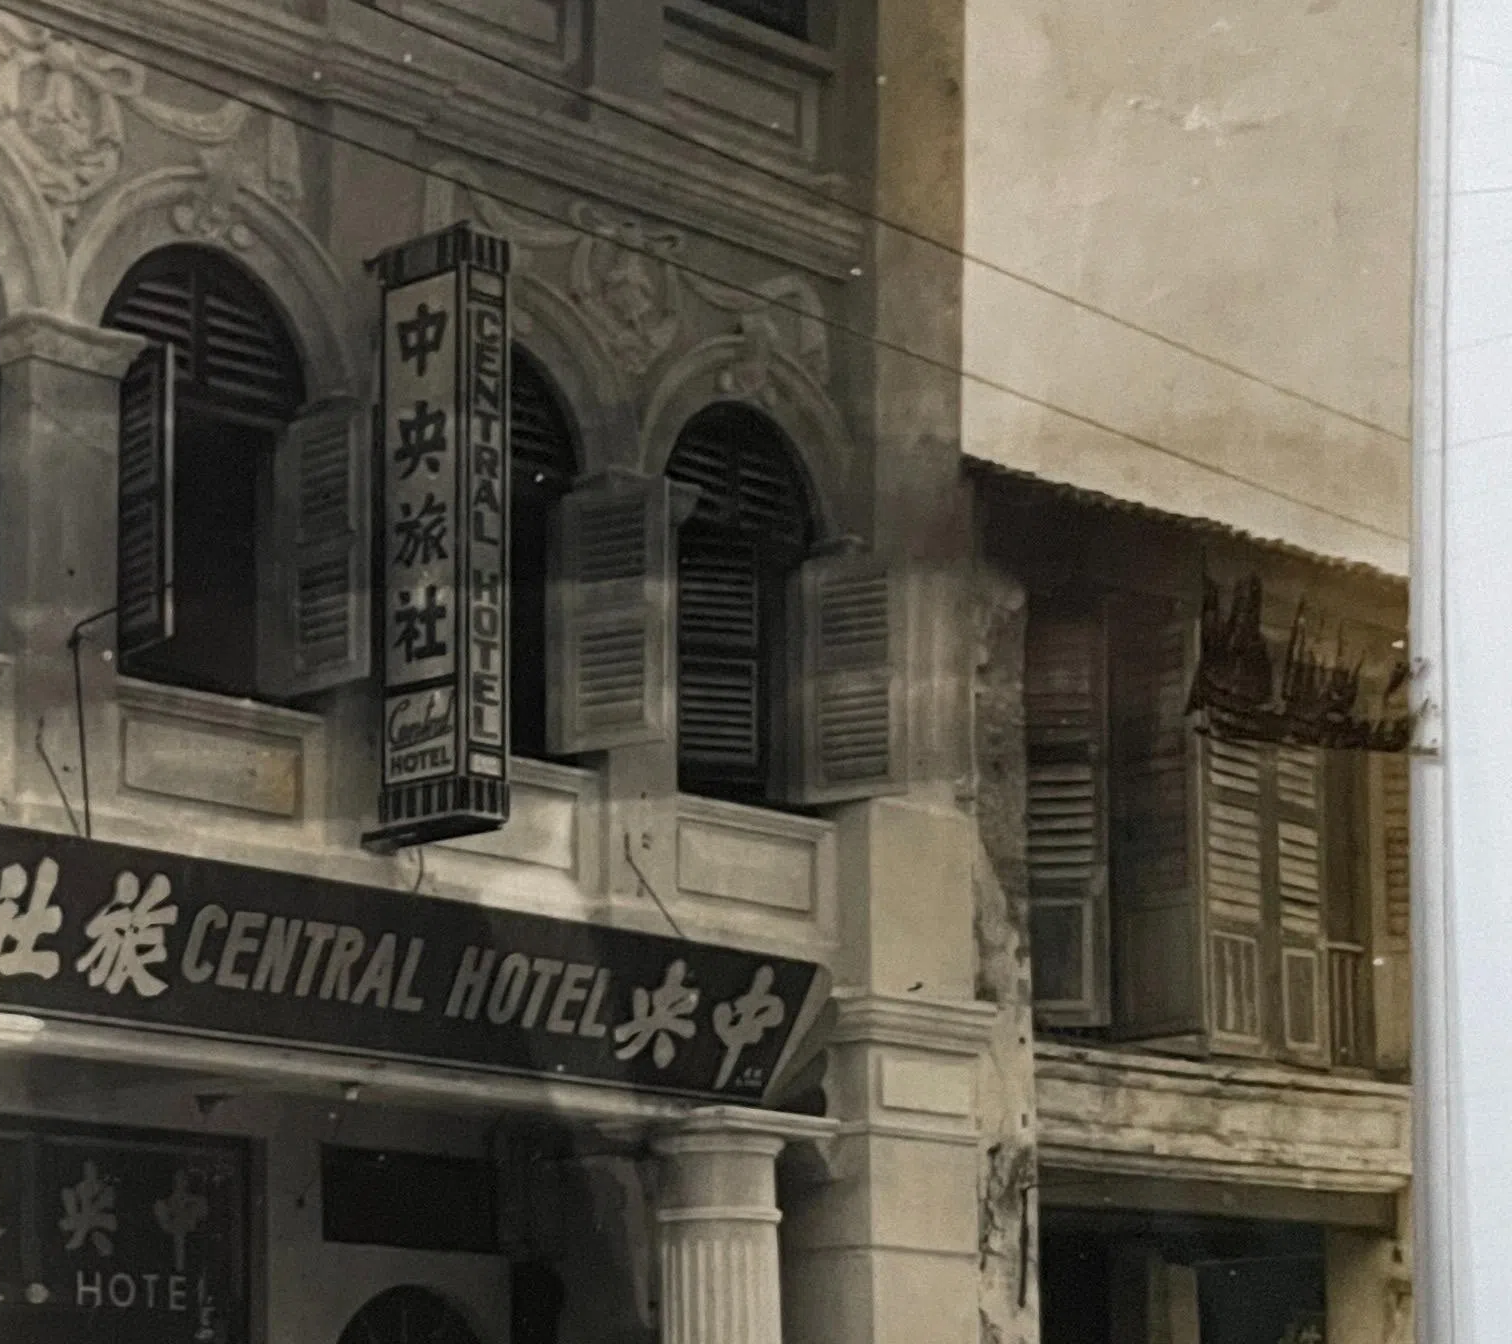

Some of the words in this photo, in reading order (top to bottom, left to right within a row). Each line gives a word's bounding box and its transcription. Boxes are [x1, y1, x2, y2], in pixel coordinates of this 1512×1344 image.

[392, 302, 449, 664] 中央旅社
[472, 309, 501, 547] CENTRAL
[472, 568, 500, 740] HOTEL
[390, 745, 452, 777] HOTEL
[180, 903, 425, 1013] CENTRAL
[443, 945, 614, 1040] HOTEL
